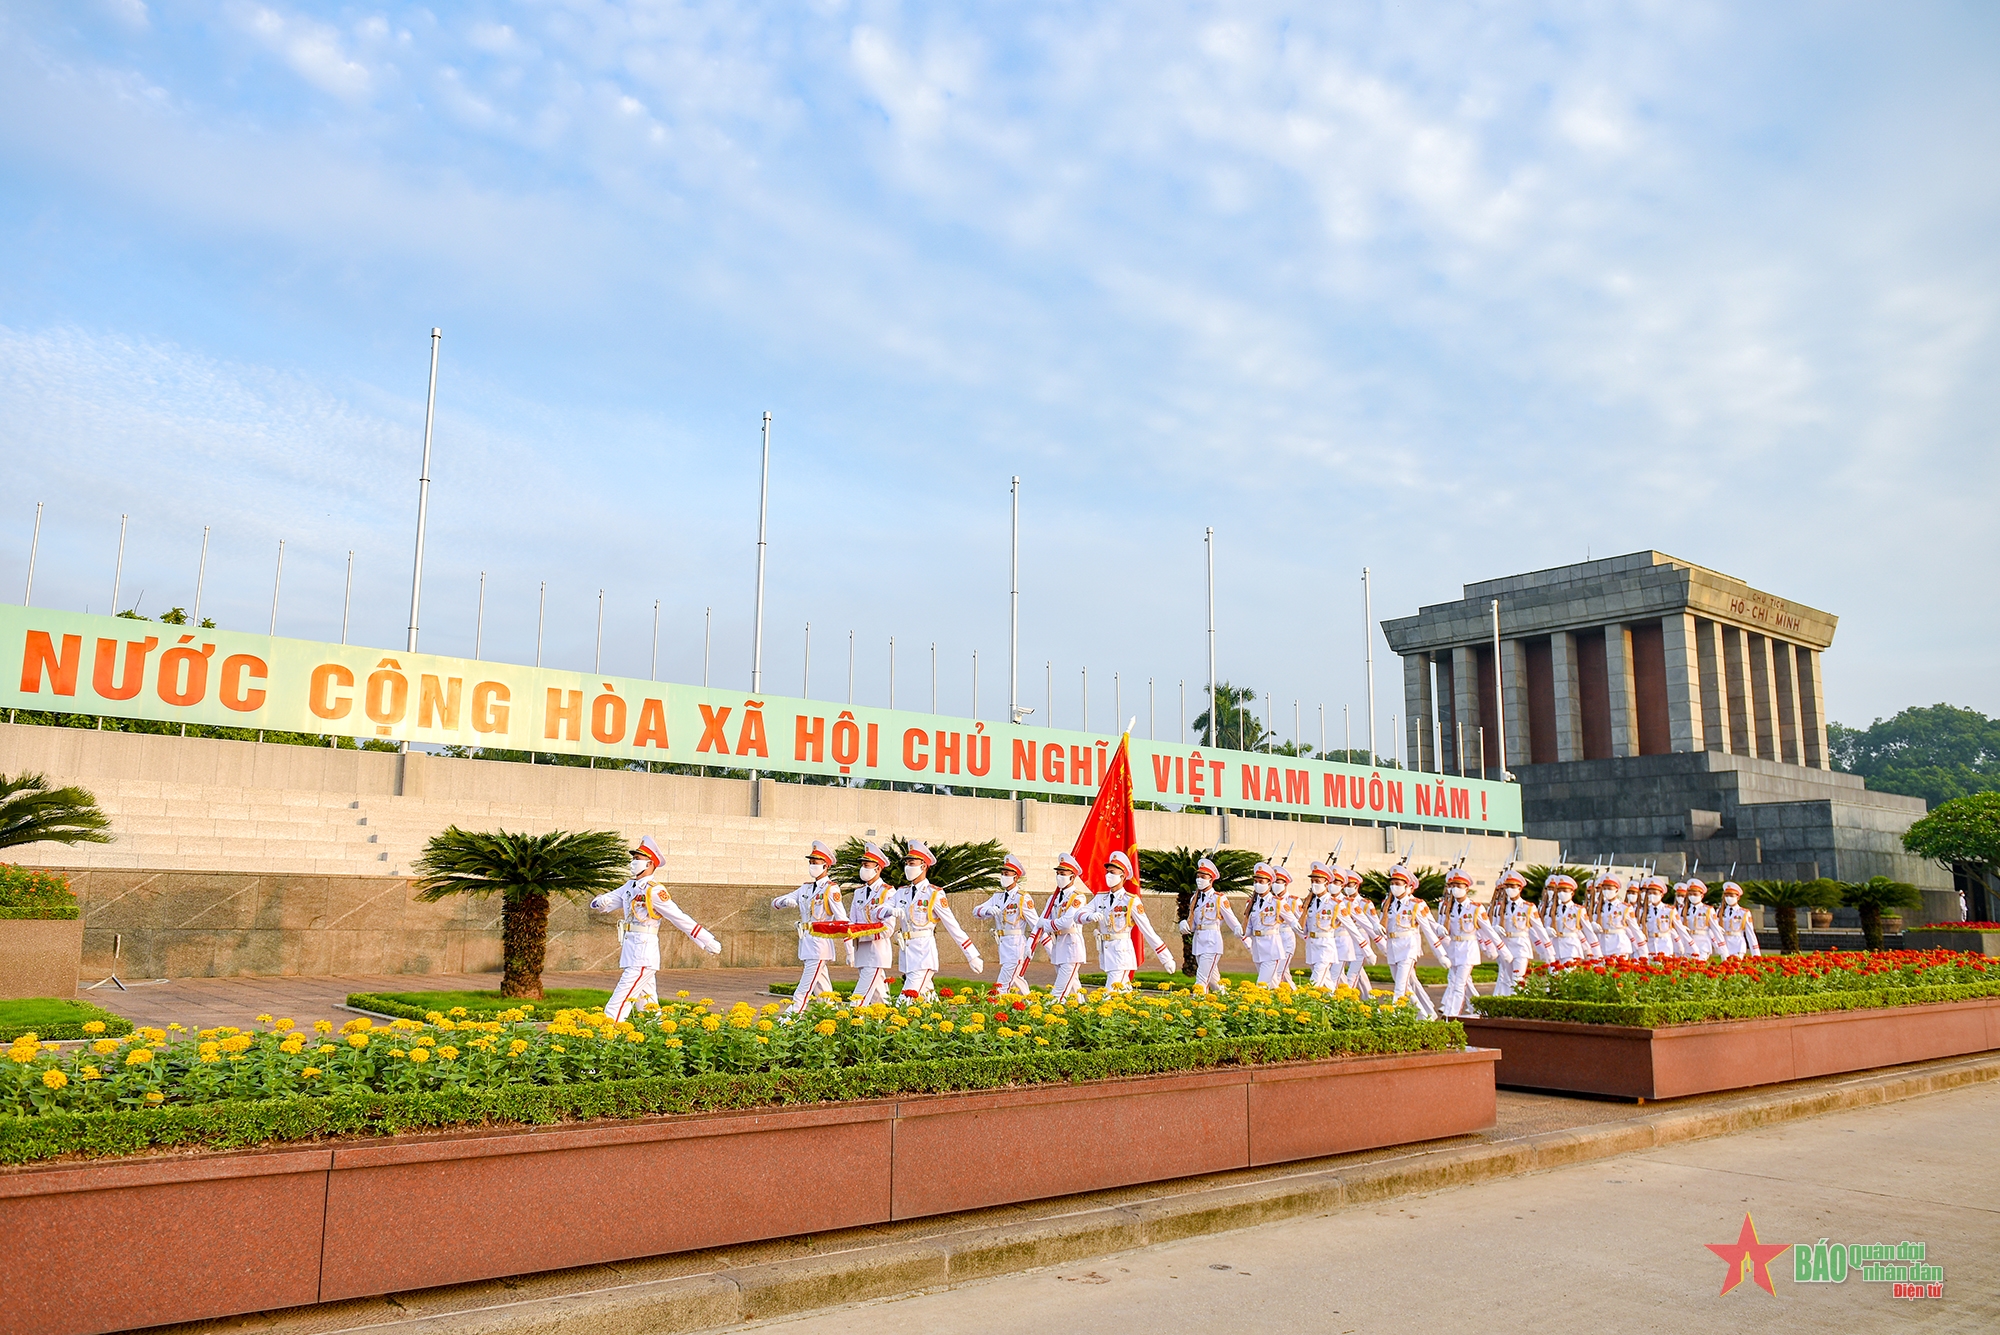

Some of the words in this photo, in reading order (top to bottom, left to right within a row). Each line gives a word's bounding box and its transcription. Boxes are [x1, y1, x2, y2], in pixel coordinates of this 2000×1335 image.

[20, 630, 269, 712] NƯỚC
[309, 658, 511, 736] CỘNG
[545, 683, 670, 750] HÒA
[697, 700, 769, 759] XÃ
[795, 711, 879, 774] HỘI
[903, 722, 991, 777] CHỦ
[1012, 739, 1109, 787] NGHĨ
[1152, 751, 1226, 803] VIỆT
[1242, 764, 1310, 805] NAM
[1324, 772, 1404, 814] MUÔN
[1416, 779, 1471, 820] NĂM
